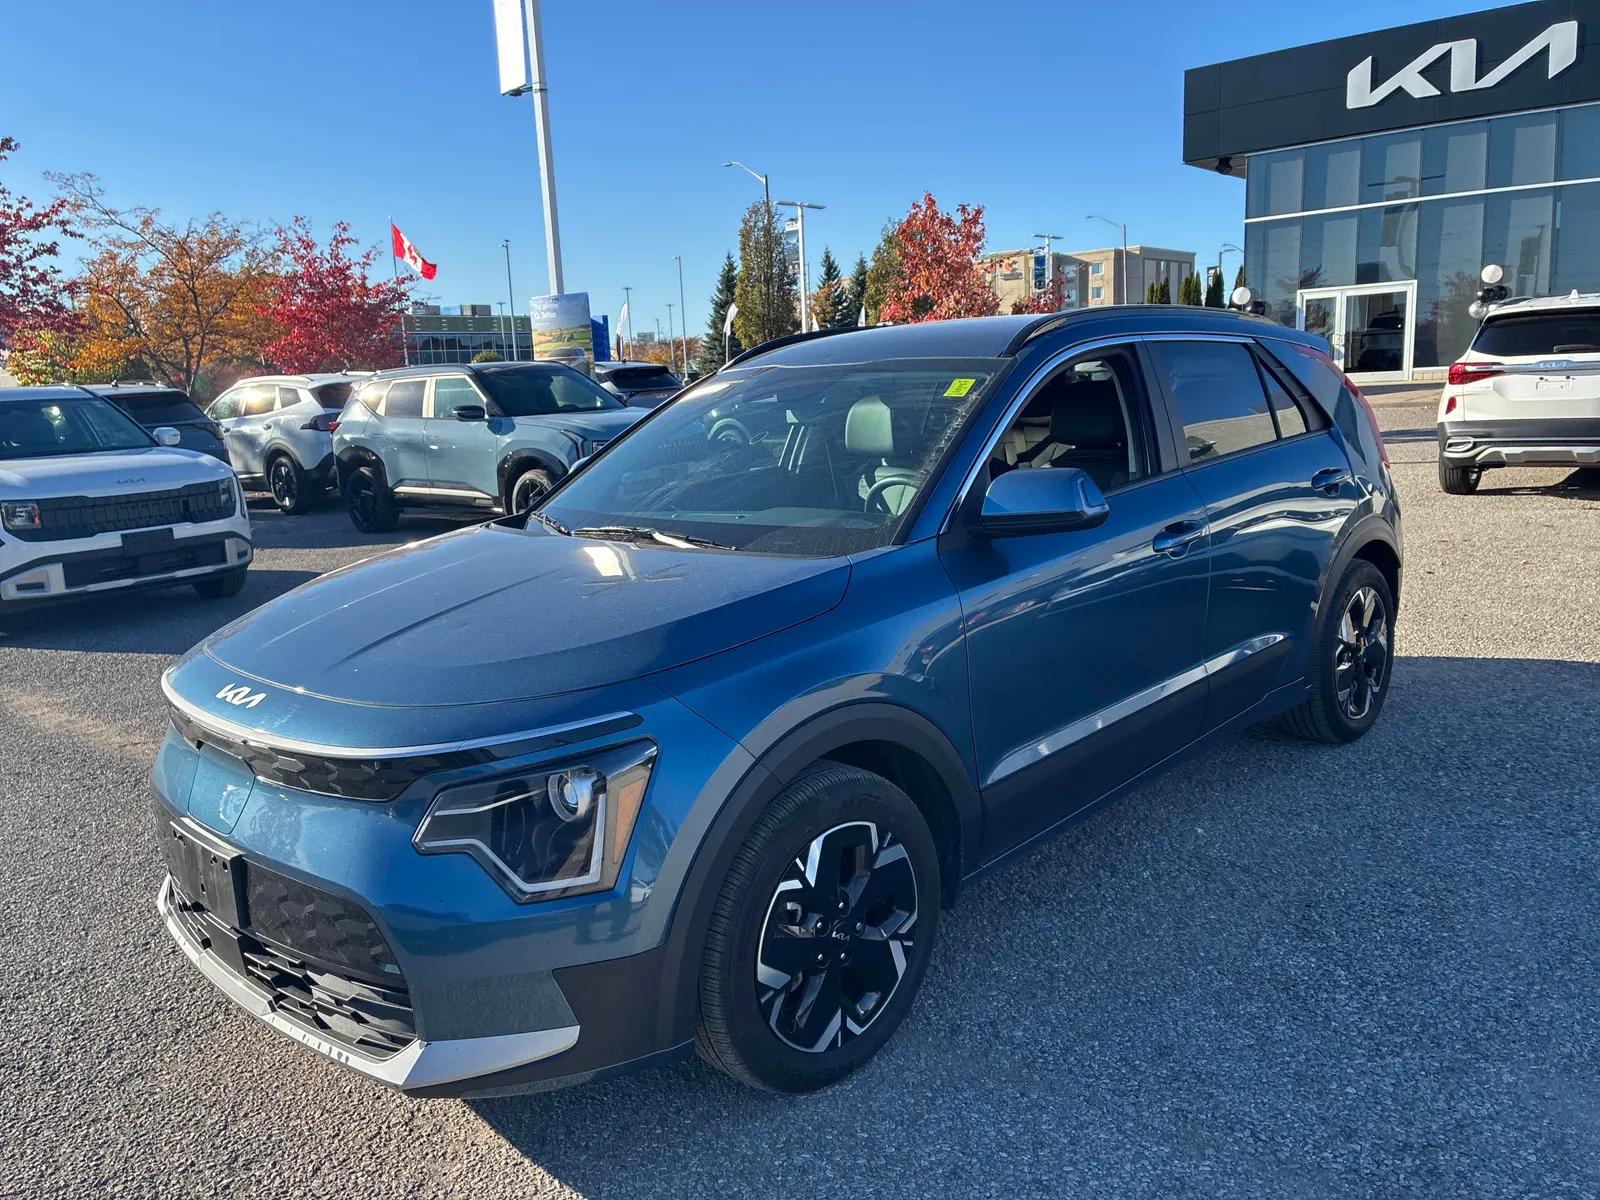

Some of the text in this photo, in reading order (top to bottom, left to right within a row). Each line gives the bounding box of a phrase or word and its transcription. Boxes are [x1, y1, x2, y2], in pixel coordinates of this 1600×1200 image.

[1346, 20, 1579, 109] KIA
[1539, 361, 1568, 369] KIA
[116, 477, 146, 485] KIA
[215, 682, 267, 709] KIA
[831, 930, 851, 941] KIA
